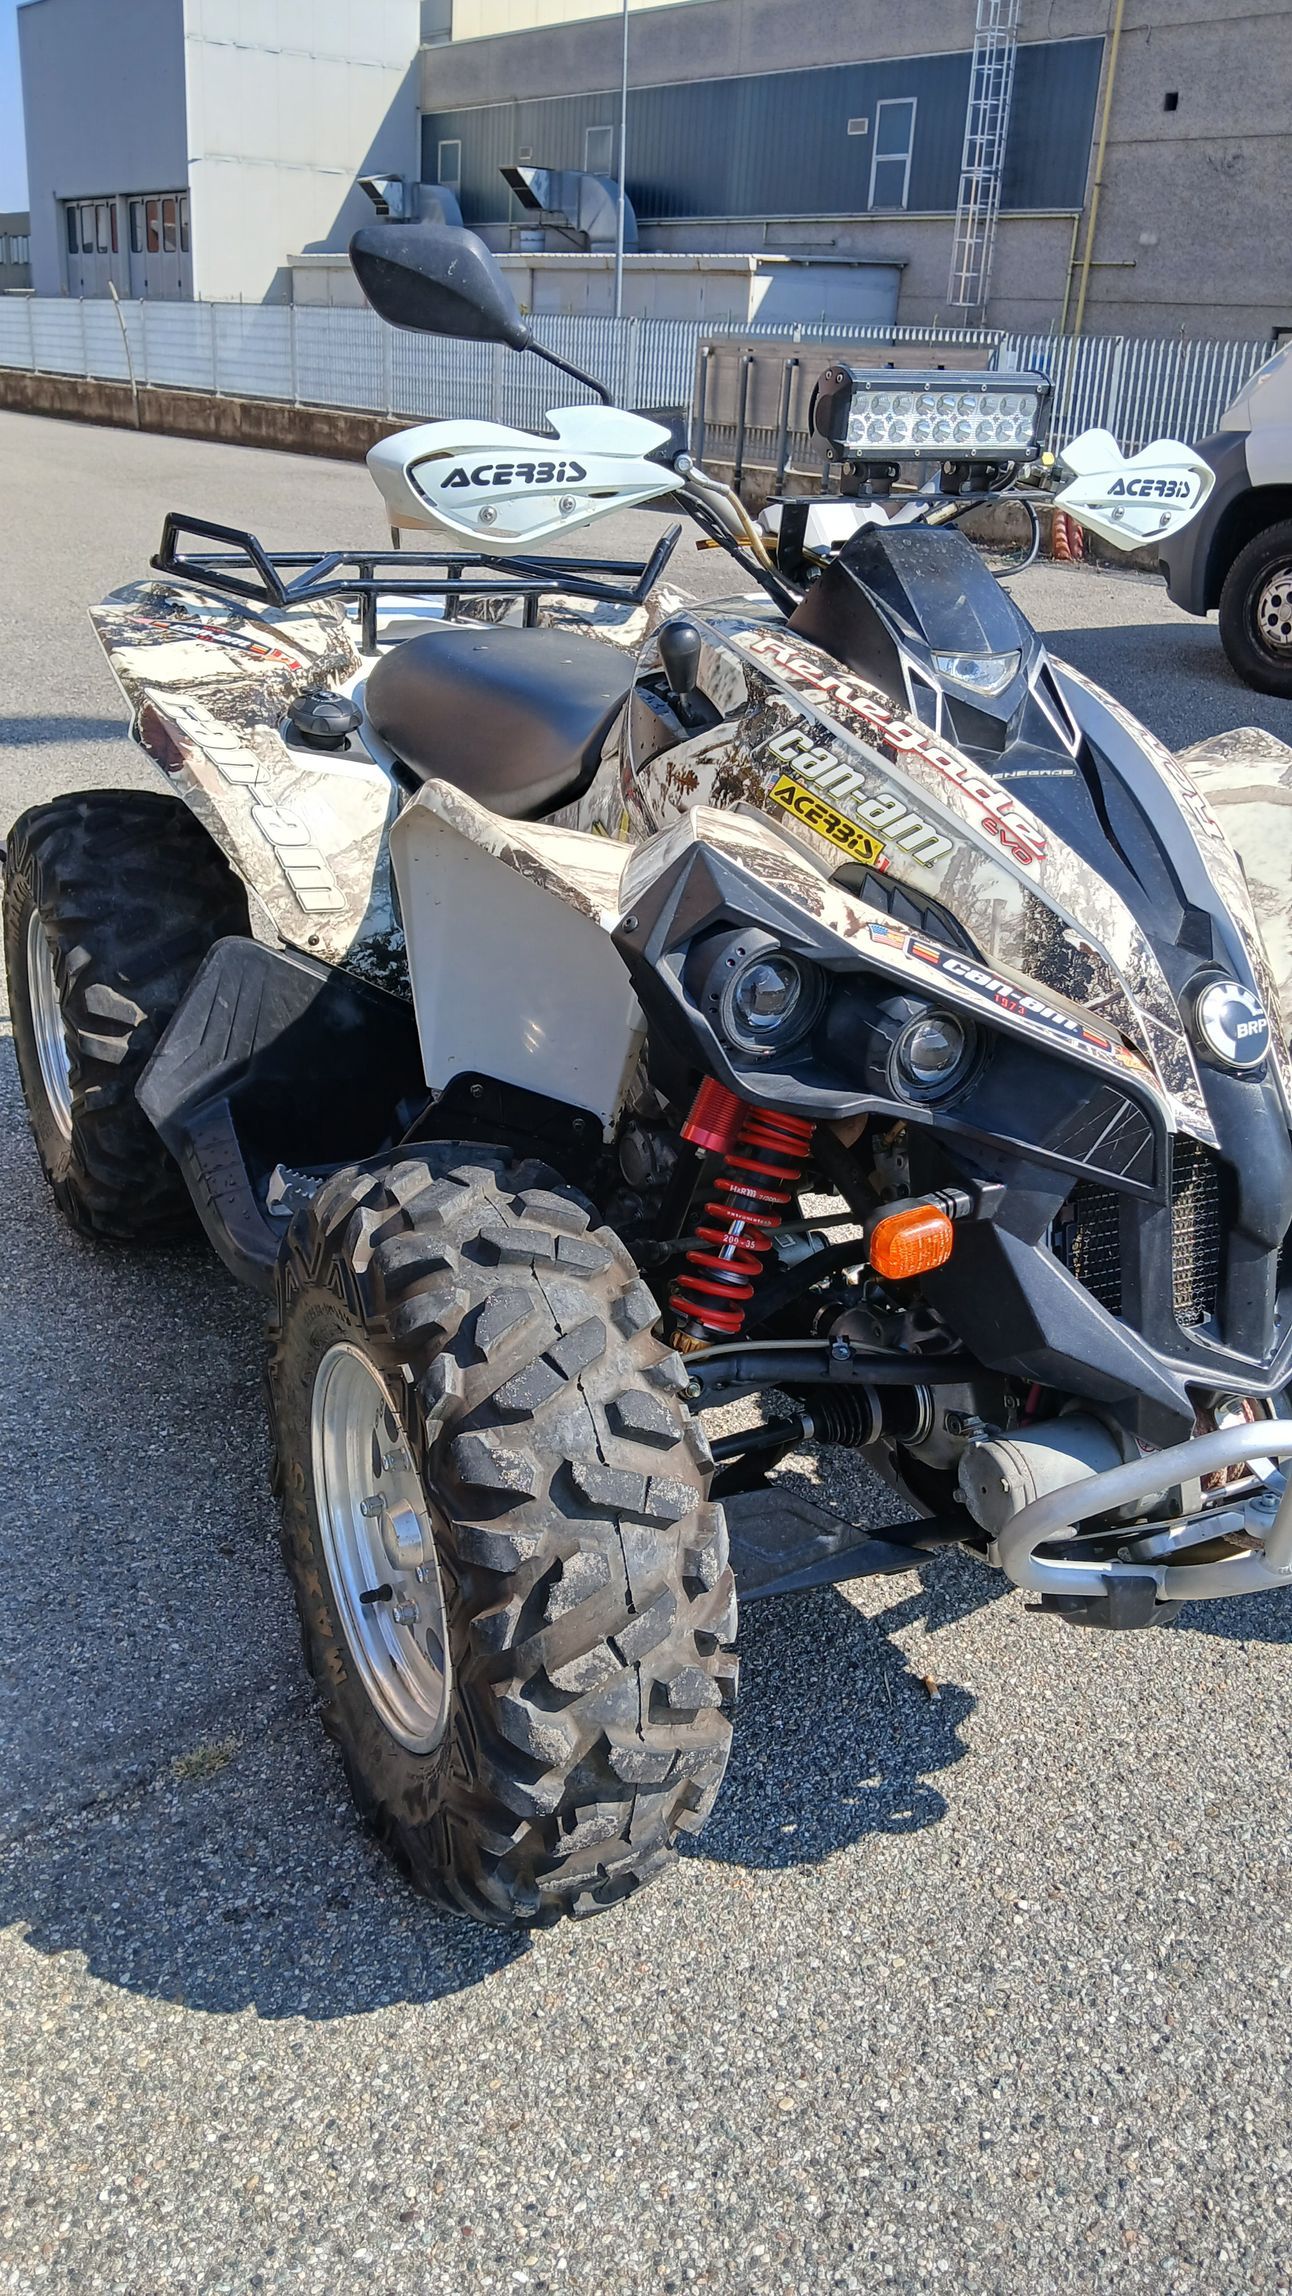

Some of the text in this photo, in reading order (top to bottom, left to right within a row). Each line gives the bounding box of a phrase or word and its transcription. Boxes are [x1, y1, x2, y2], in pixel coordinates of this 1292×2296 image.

[440, 461, 587, 488] ACERBIS
[1107, 478, 1190, 498] ACERBIS
[751, 637, 1047, 859] Renegade
[990, 769, 1075, 780] ENEGADE
[143, 687, 348, 913] can-am
[768, 728, 953, 864] can-am
[773, 785, 878, 859] ACERBIS
[942, 957, 1079, 1034] can-am
[1236, 1018, 1267, 1039] BRP
